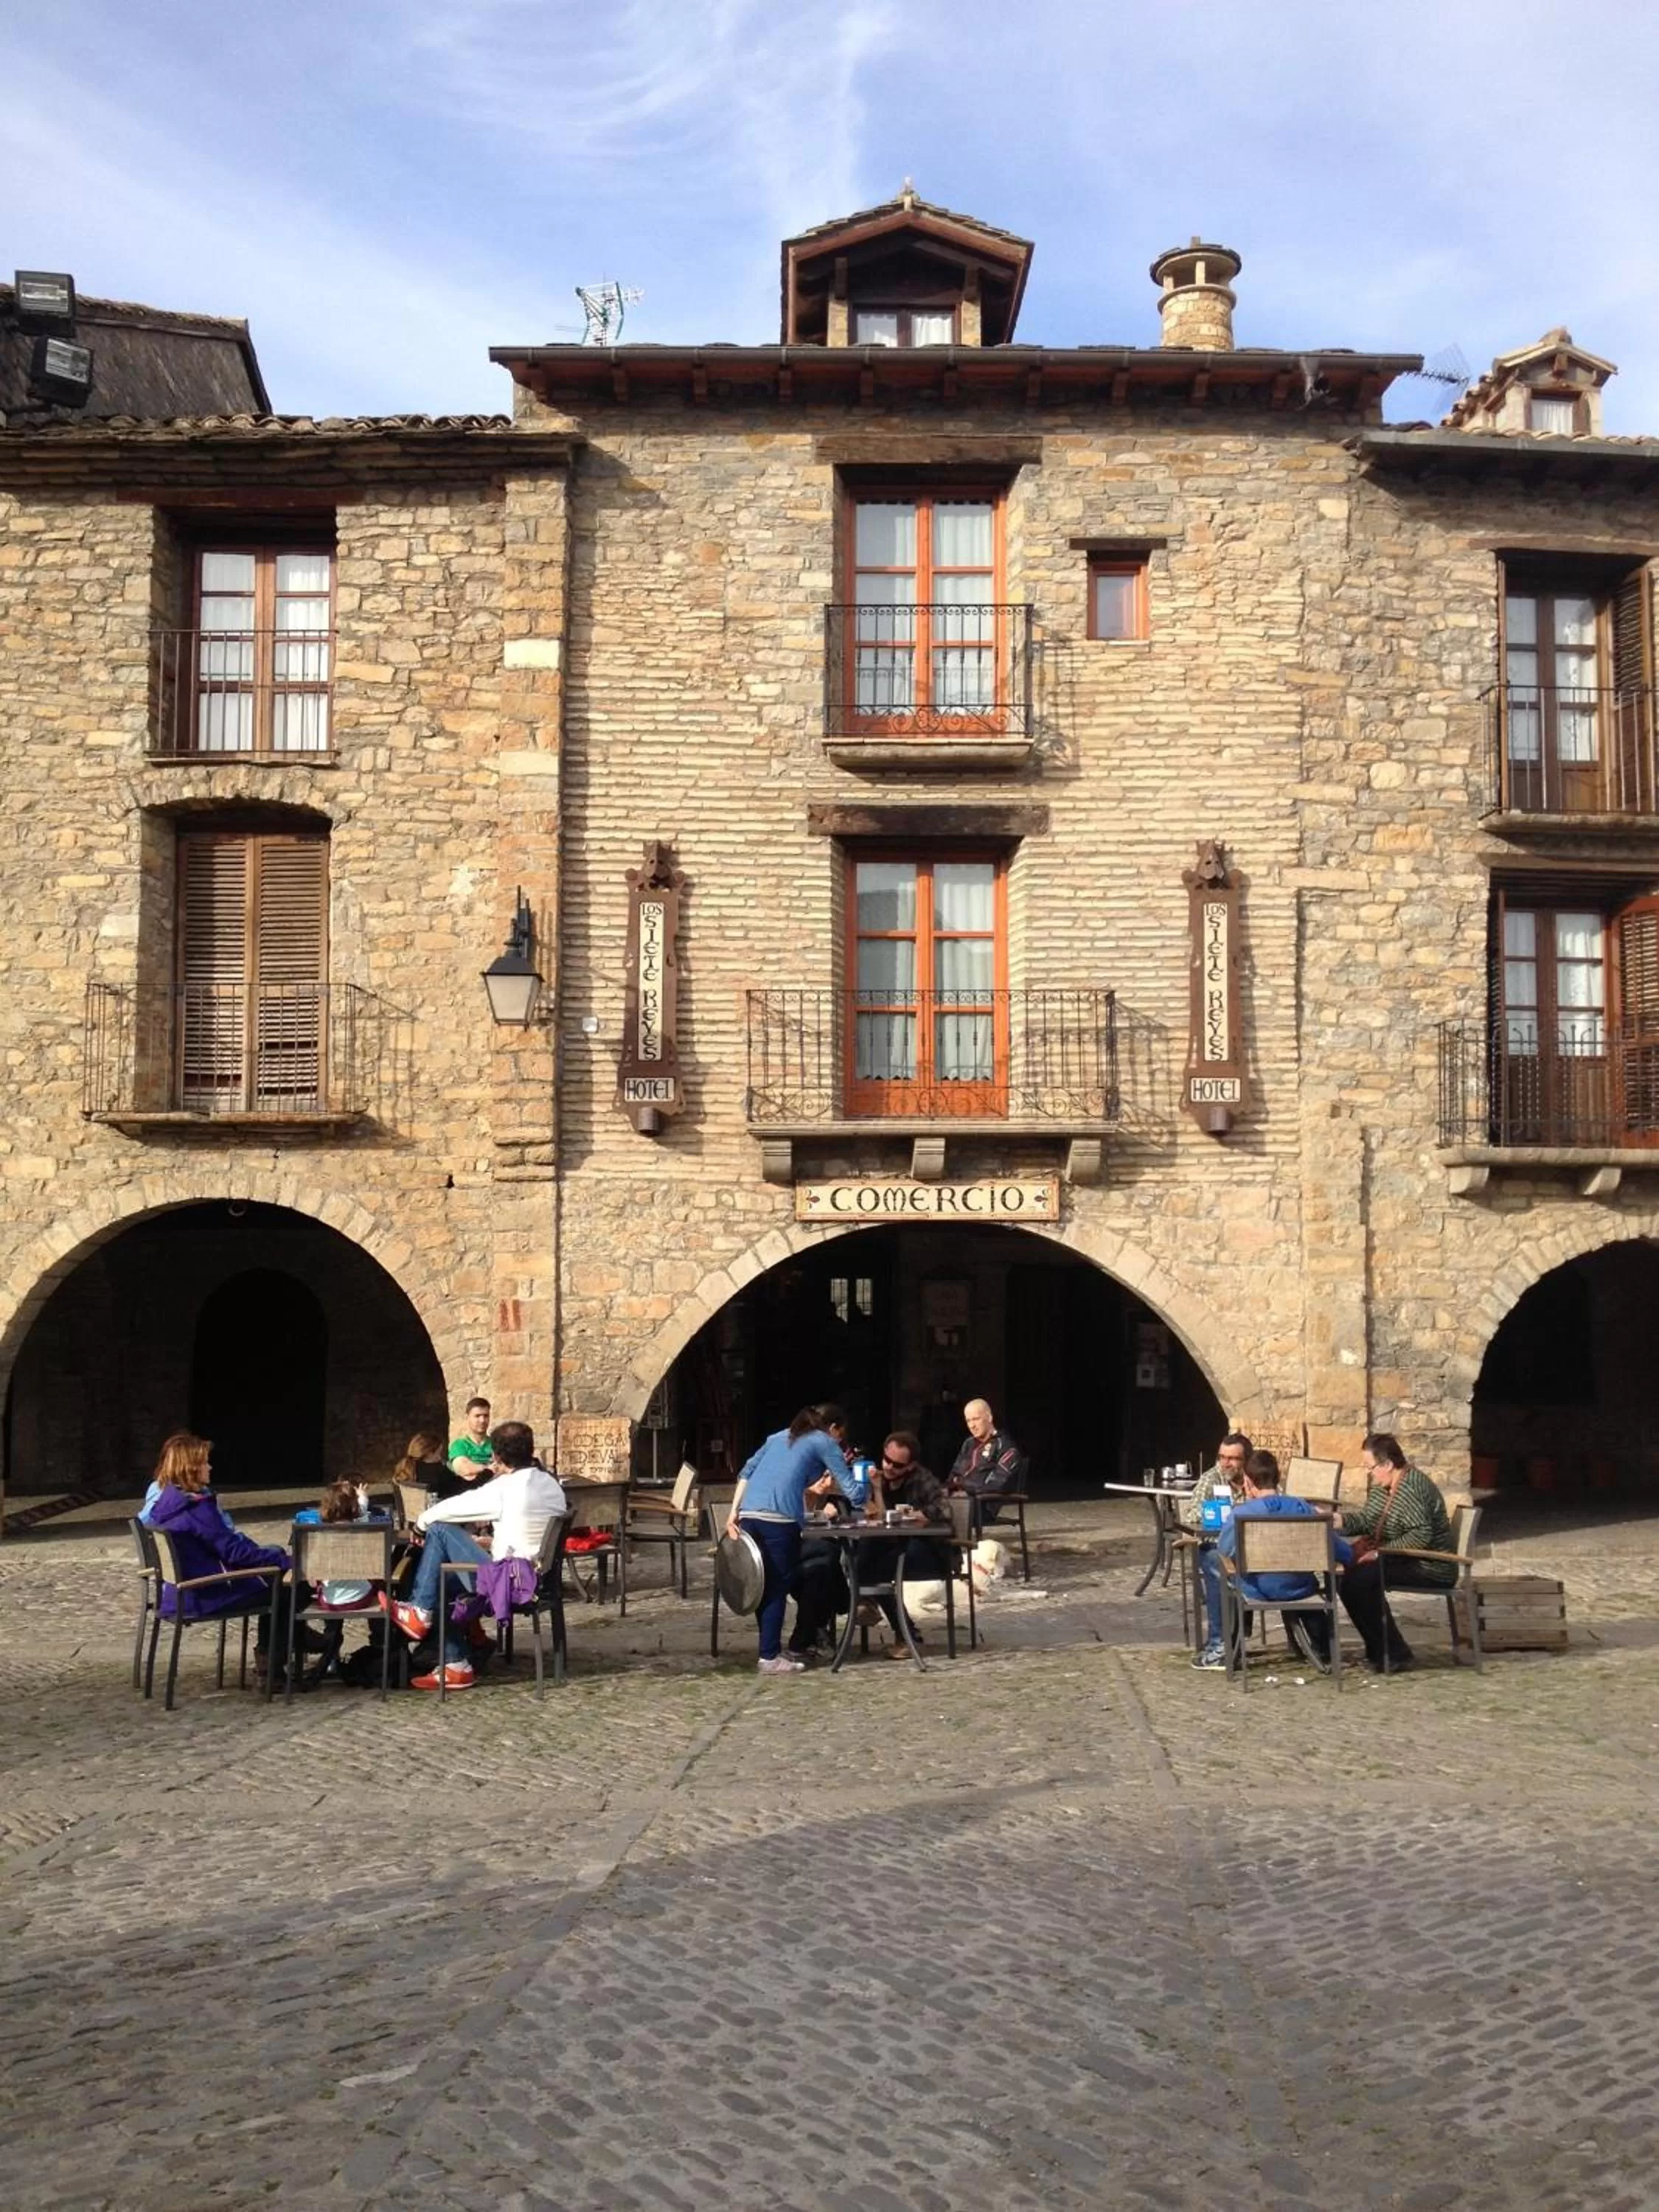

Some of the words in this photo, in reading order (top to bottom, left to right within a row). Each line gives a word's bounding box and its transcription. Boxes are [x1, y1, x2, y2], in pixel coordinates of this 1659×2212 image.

[642, 904, 662, 915] LOS
[1206, 904, 1226, 915] LOS
[643, 915, 660, 981] SIETE
[1208, 915, 1224, 981] SIETE
[641, 989, 658, 1061] REYES
[1207, 989, 1224, 1061] REYES
[627, 1079, 671, 1099] HOTEL
[1193, 1079, 1239, 1101] HOTEL
[1249, 1431, 1301, 1449] ODEGA
